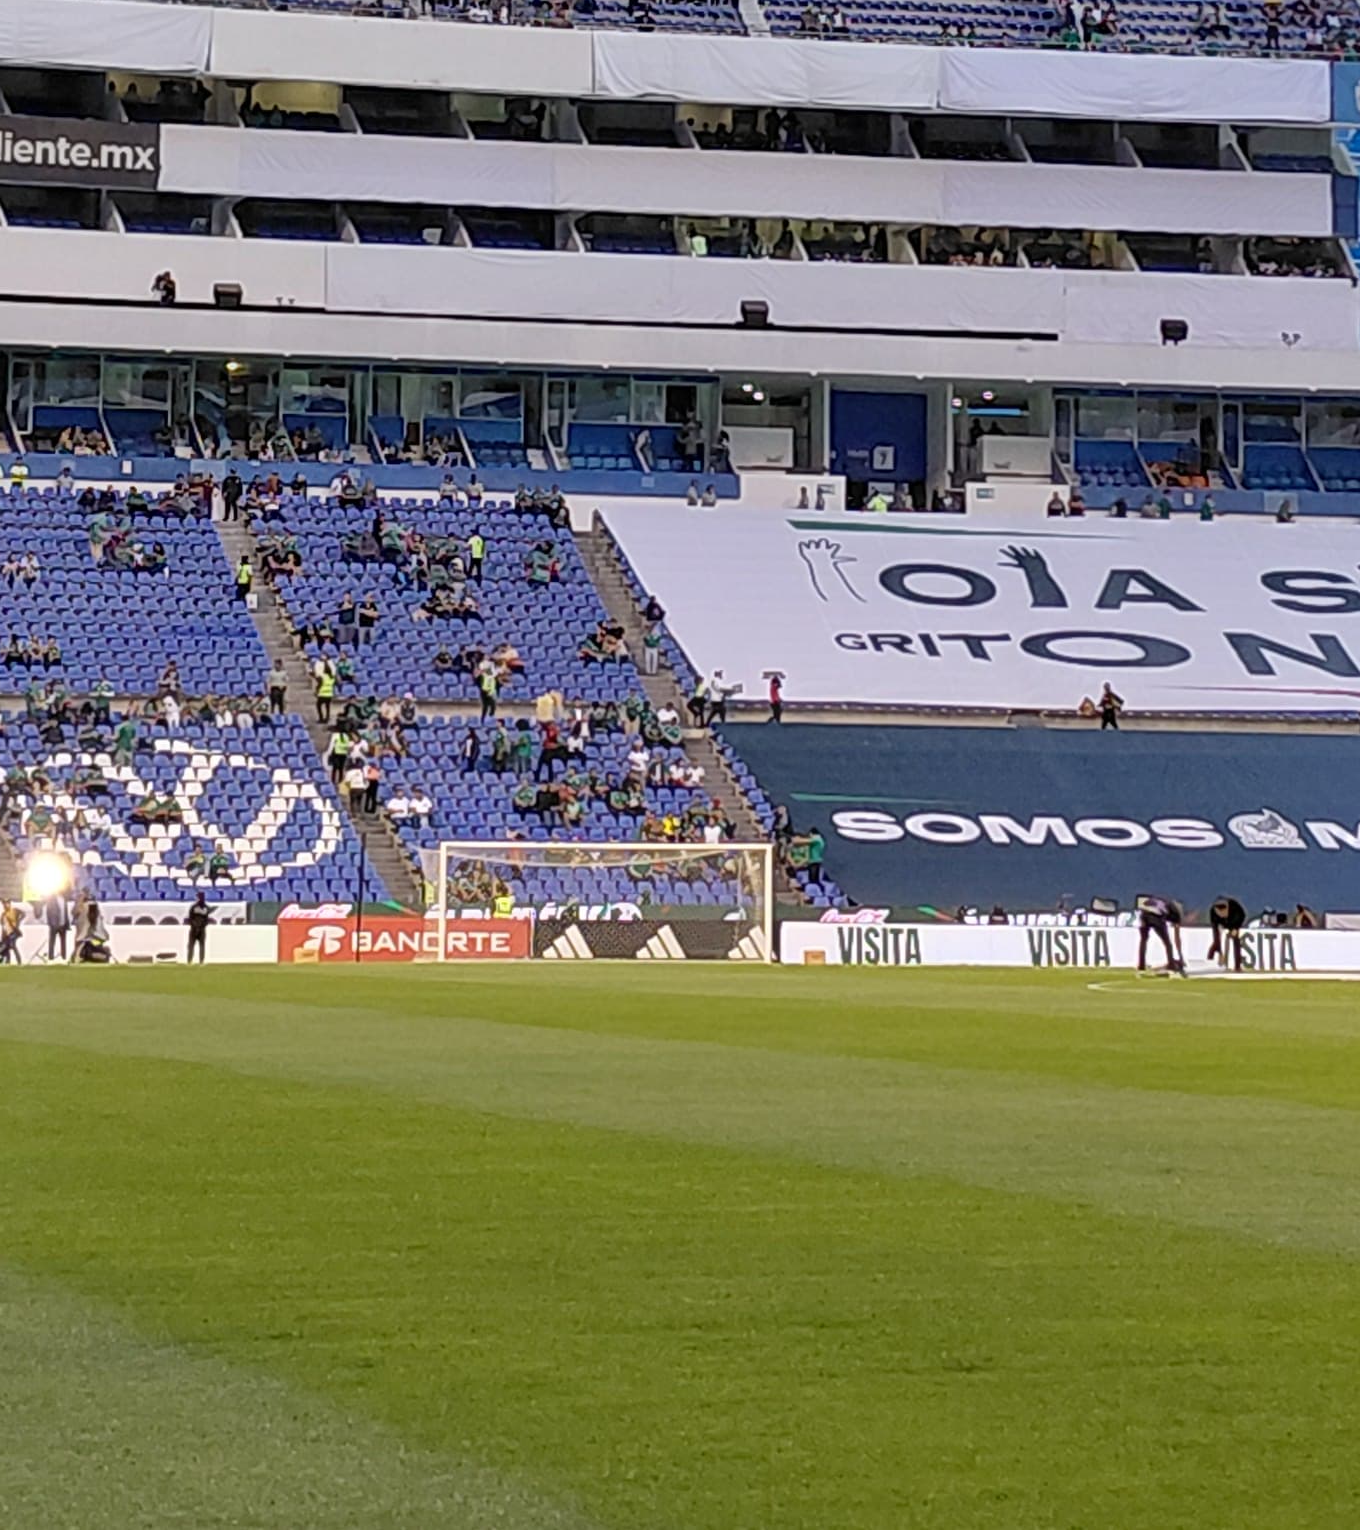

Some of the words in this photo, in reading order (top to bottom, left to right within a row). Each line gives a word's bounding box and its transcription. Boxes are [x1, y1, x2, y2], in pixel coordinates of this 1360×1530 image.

[835, 631, 1192, 668] GRITO
[832, 810, 1223, 850] SOMOS
[352, 930, 511, 953] BANORTE
[837, 927, 922, 965] VISITA
[1027, 928, 1111, 967] VISITA
